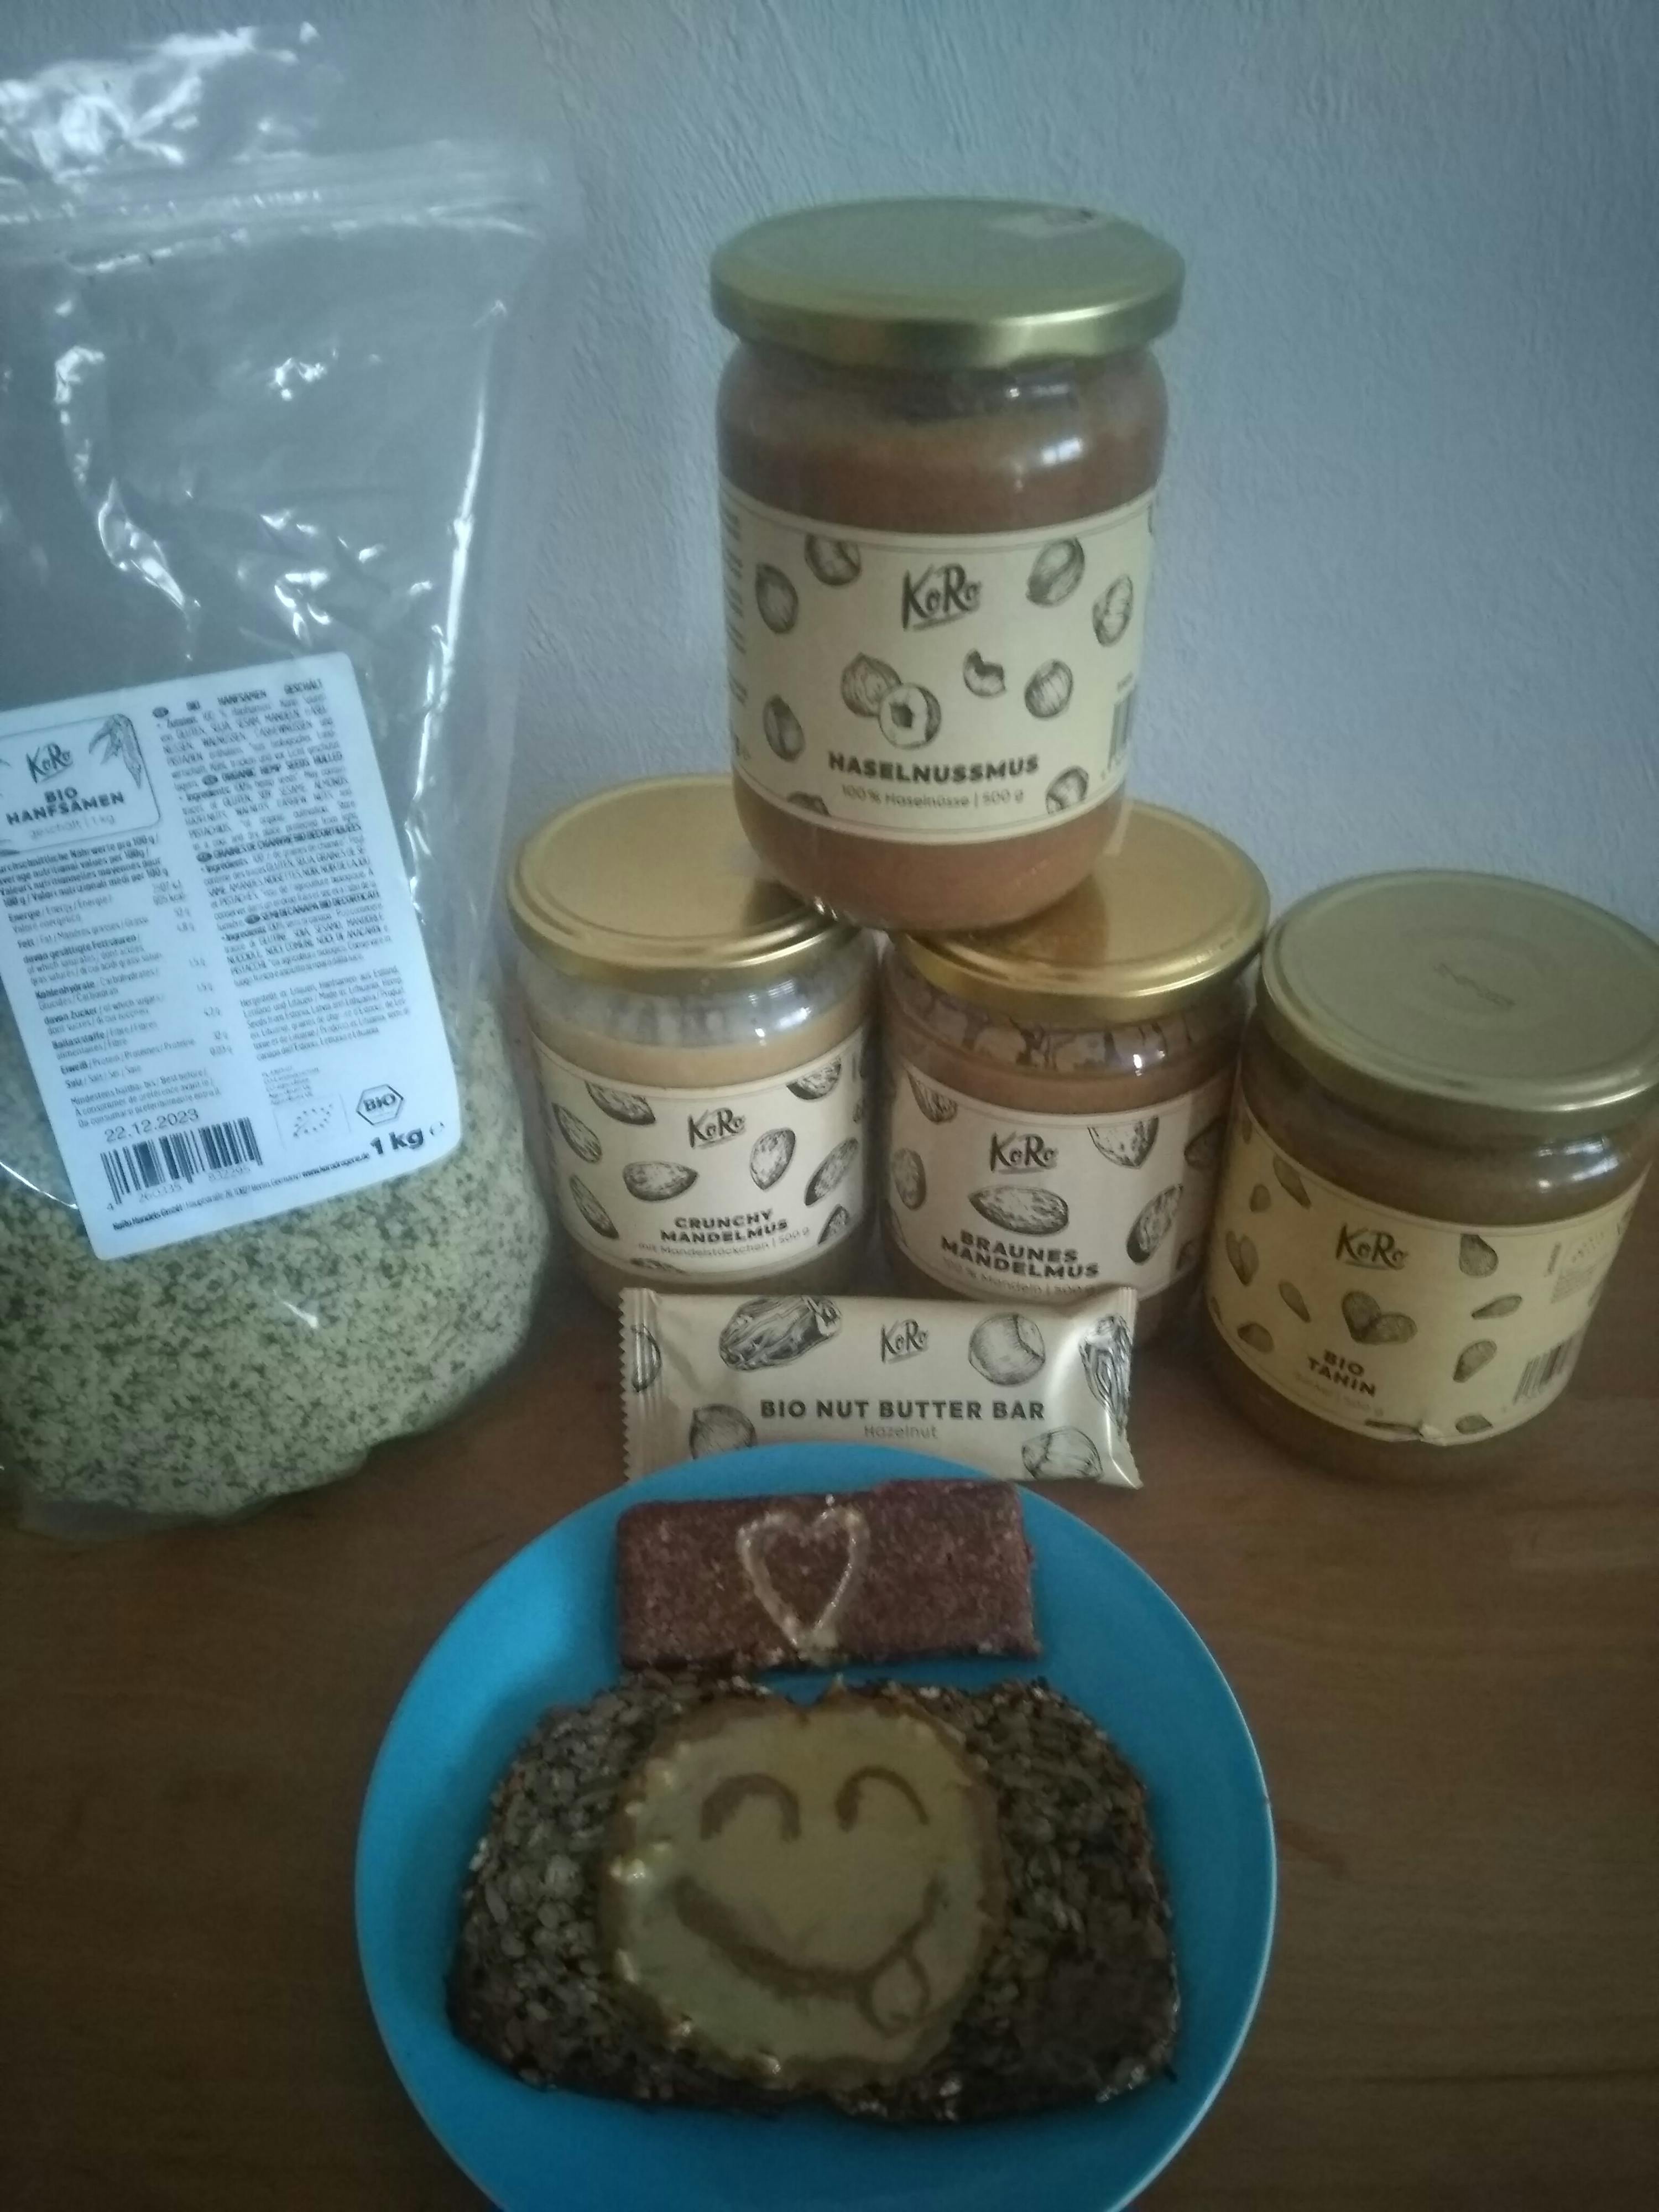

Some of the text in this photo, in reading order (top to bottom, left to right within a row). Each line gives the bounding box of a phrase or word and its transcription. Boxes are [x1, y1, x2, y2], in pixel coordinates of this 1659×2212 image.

[901, 563, 983, 632] KoRo
[26, 743, 73, 783] KoRo
[828, 751, 1039, 784] HASELNUSSMUS
[6, 791, 125, 826] HANFSAMEN
[44, 786, 77, 802] BIO
[982, 789, 1010, 806] 500
[363, 1093, 396, 1112] BIO
[105, 1108, 200, 1142] 22.12.2023
[370, 1128, 424, 1155] 1 kg
[687, 1107, 746, 1149] KoRo
[990, 1131, 1059, 1174] KoRo
[660, 1219, 787, 1243] MANDELMUS
[674, 1208, 773, 1229] CRUNCHY
[941, 1235, 1100, 1280] MANDELMUS
[960, 1229, 1078, 1263] BRAUNES
[1335, 1222, 1408, 1271] KoRo
[880, 1319, 929, 1364] KoRo
[1324, 1349, 1365, 1377] BIO
[760, 1399, 1045, 1420] BIO NUT BUTTER BAR
[864, 1424, 938, 1439] Hazelnut
